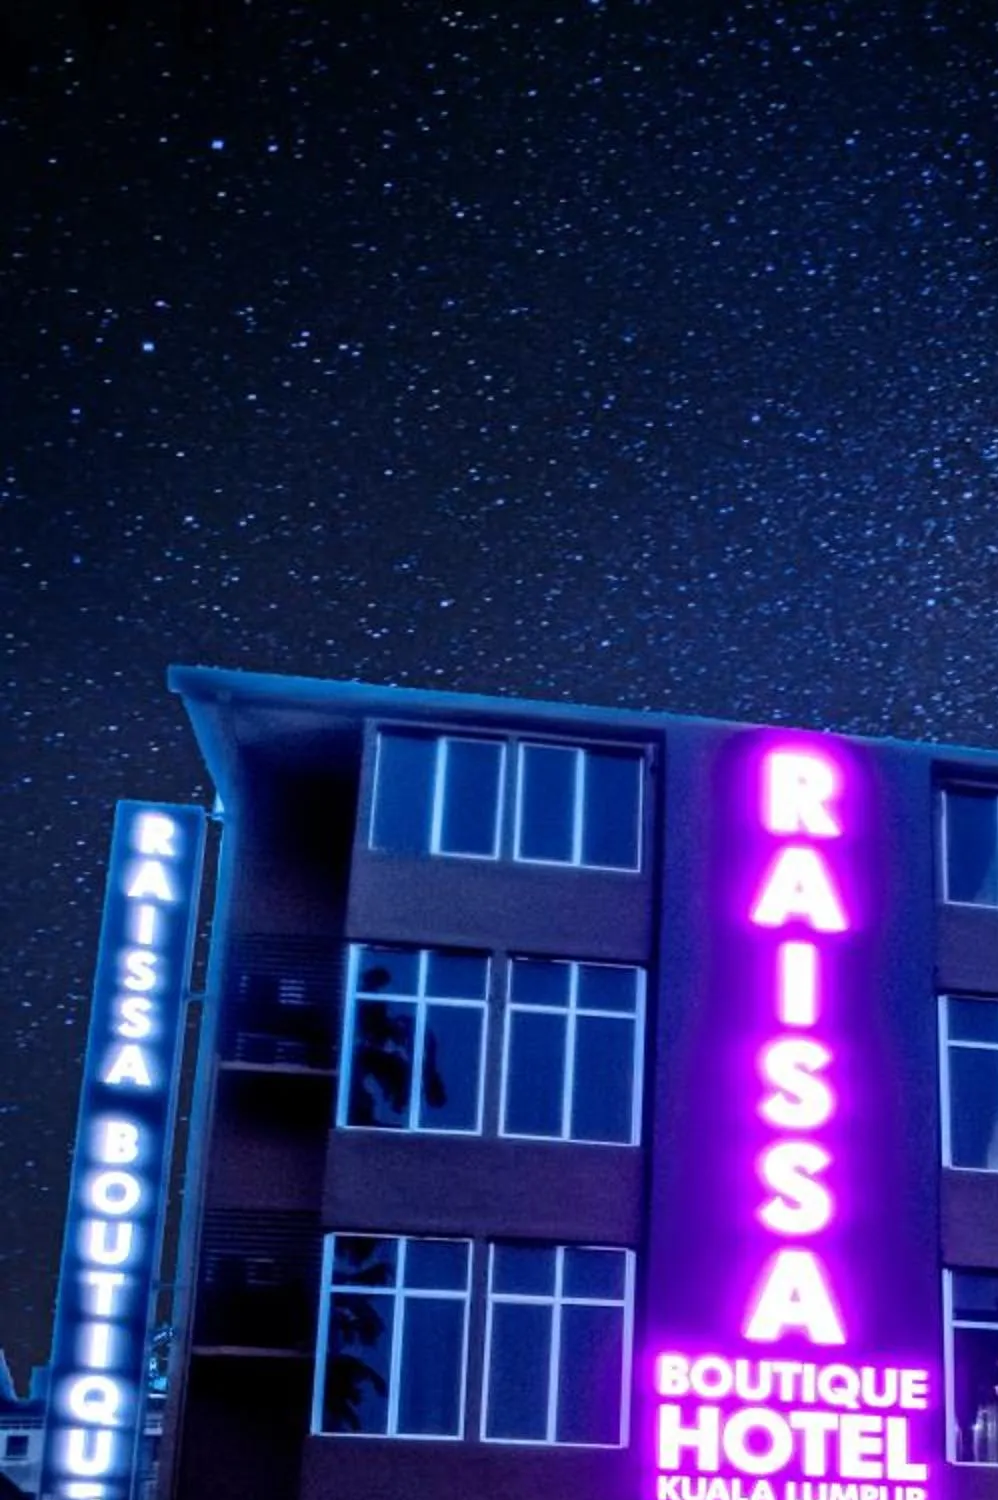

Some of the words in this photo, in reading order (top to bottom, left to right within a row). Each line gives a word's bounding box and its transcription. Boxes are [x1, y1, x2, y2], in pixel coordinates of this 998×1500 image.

[104, 813, 176, 1087] RAISSA
[743, 751, 850, 1345] RAISSA
[657, 1354, 929, 1410] BOUTIQUE
[658, 1403, 928, 1482] HOTEL
